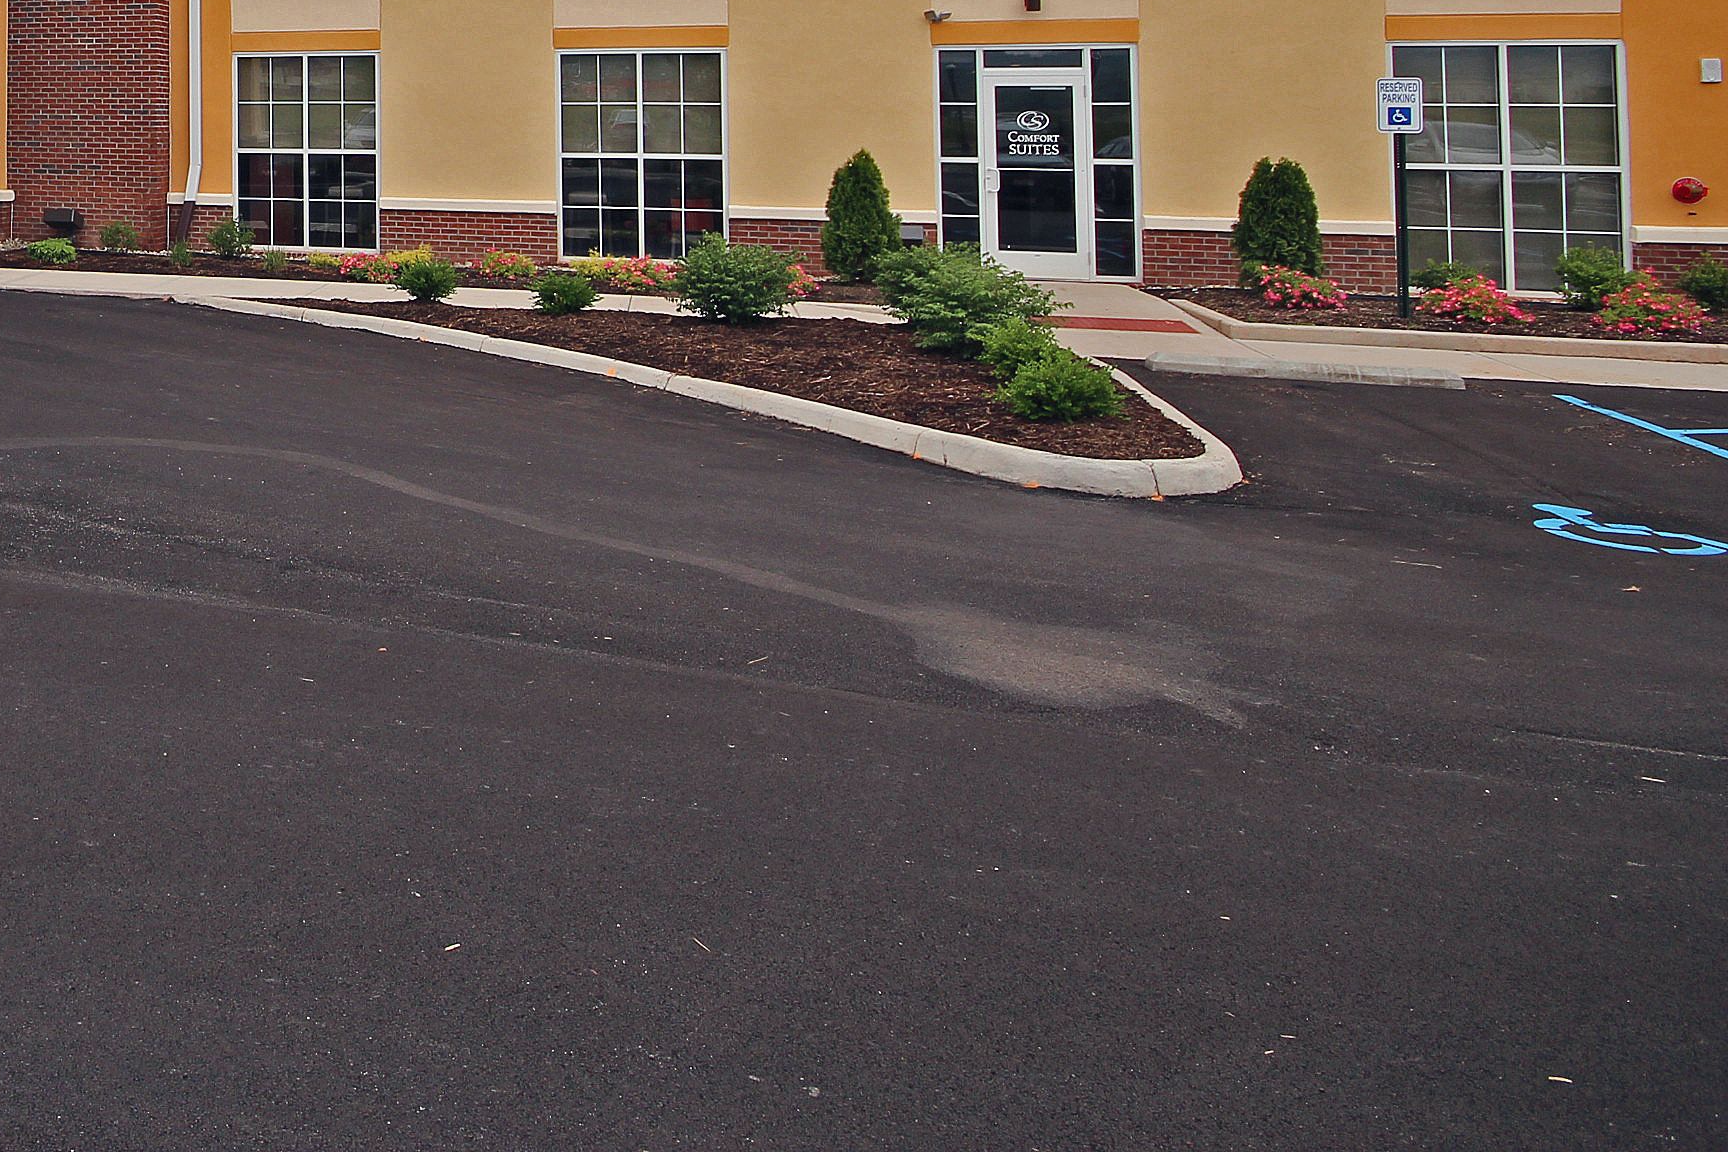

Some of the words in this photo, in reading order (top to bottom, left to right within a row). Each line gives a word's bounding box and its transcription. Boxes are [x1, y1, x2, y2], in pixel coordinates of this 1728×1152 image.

[1379, 82, 1418, 93] RESERVED
[1382, 93, 1416, 103] PARKING
[1008, 131, 1060, 143] COMFORT
[1009, 144, 1060, 155] SUITES
